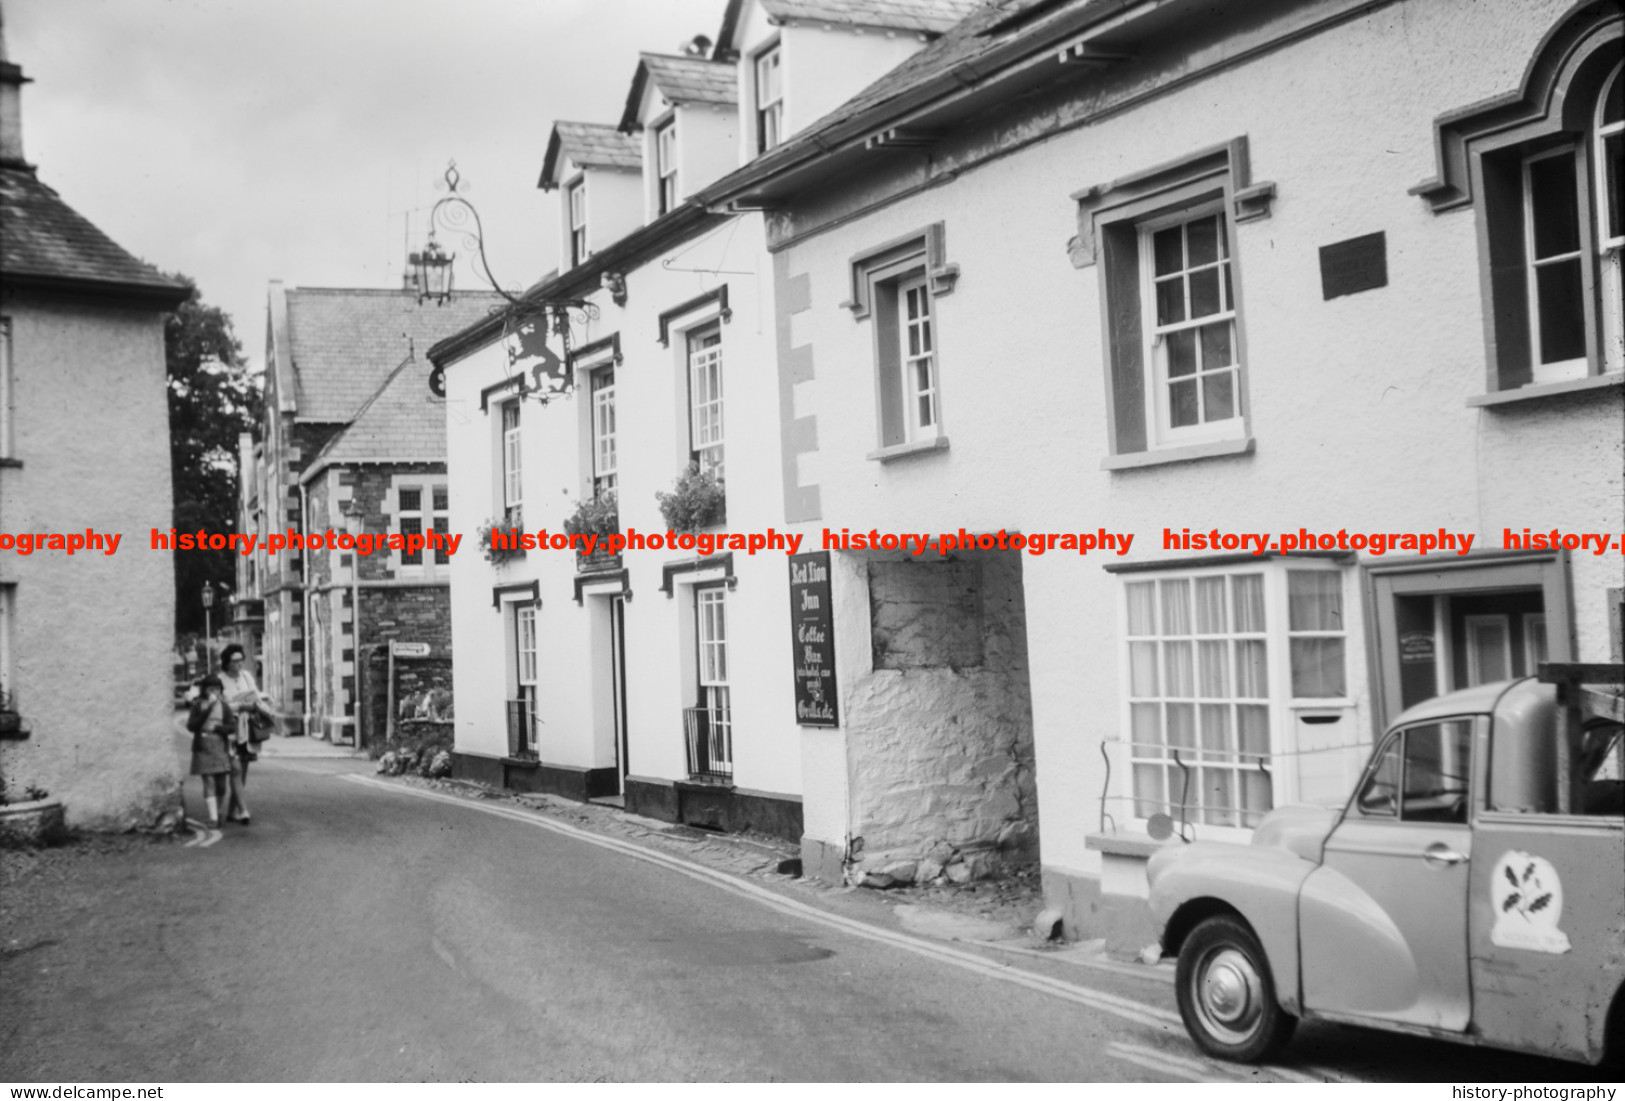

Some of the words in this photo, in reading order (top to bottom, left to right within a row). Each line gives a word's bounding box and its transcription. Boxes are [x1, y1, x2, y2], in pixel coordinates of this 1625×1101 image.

[791, 562, 808, 585] Red
[808, 561, 827, 583] Lion
[801, 589, 820, 611] Inn
[798, 623, 825, 643] Coffee
